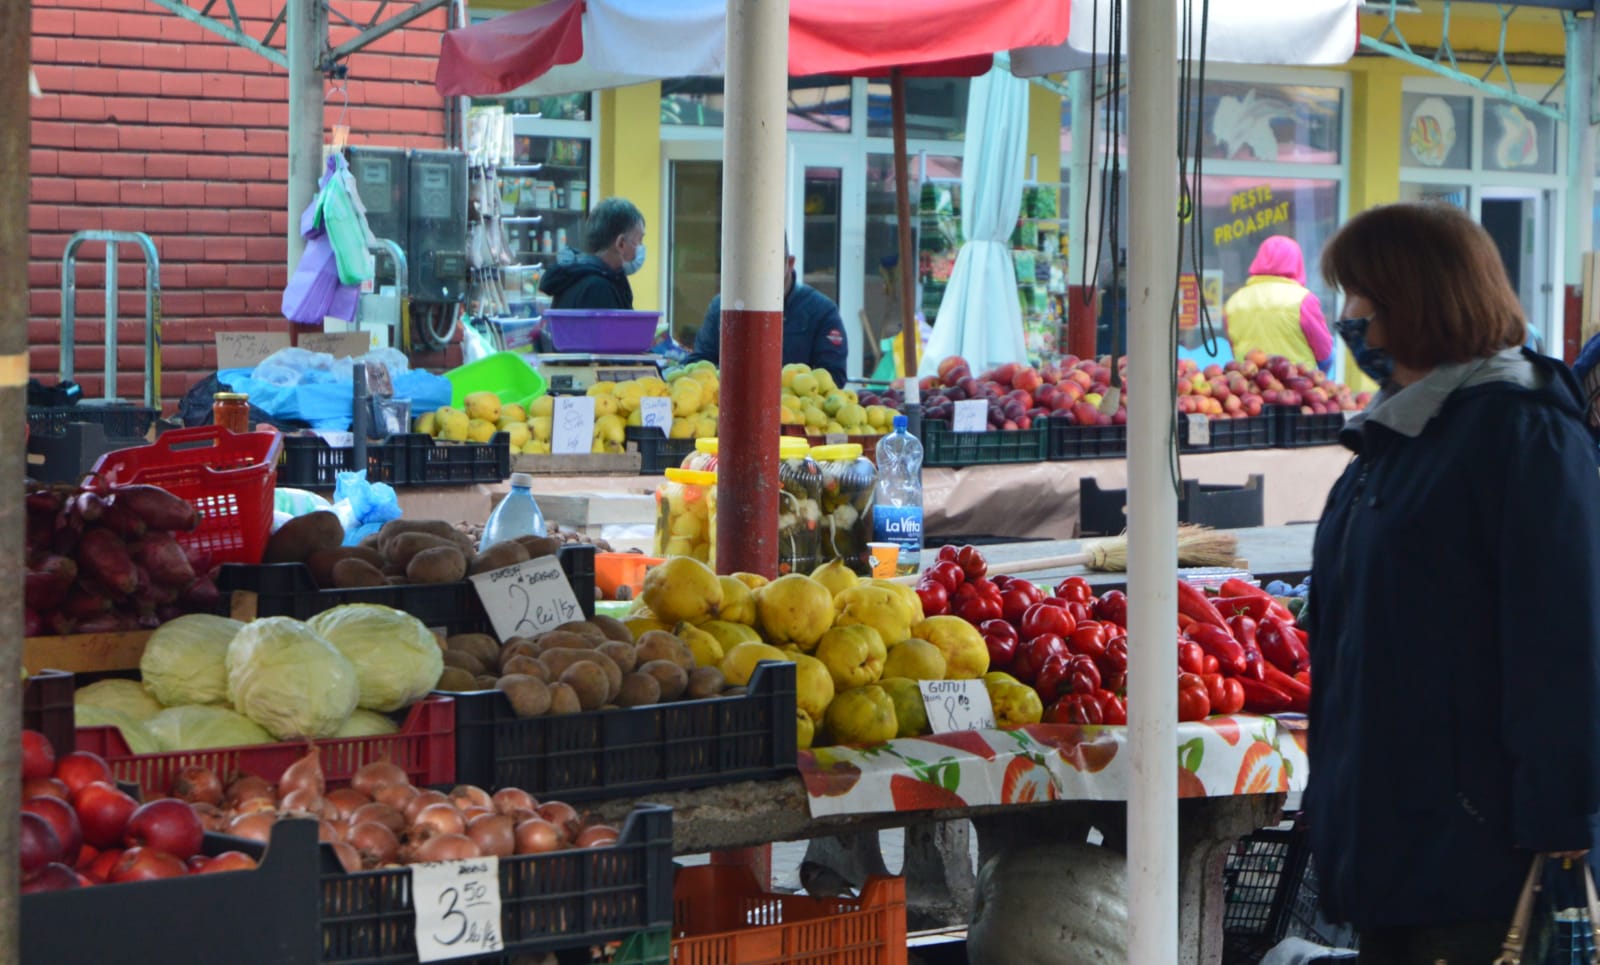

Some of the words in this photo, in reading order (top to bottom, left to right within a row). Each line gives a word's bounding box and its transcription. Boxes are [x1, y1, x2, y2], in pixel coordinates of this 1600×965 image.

[885, 517, 899, 531] La
[900, 515, 920, 532] Vitta
[508, 583, 538, 632] 2
[928, 682, 967, 694] GUTUI
[432, 886, 468, 947] 3
[463, 880, 487, 902] 50
